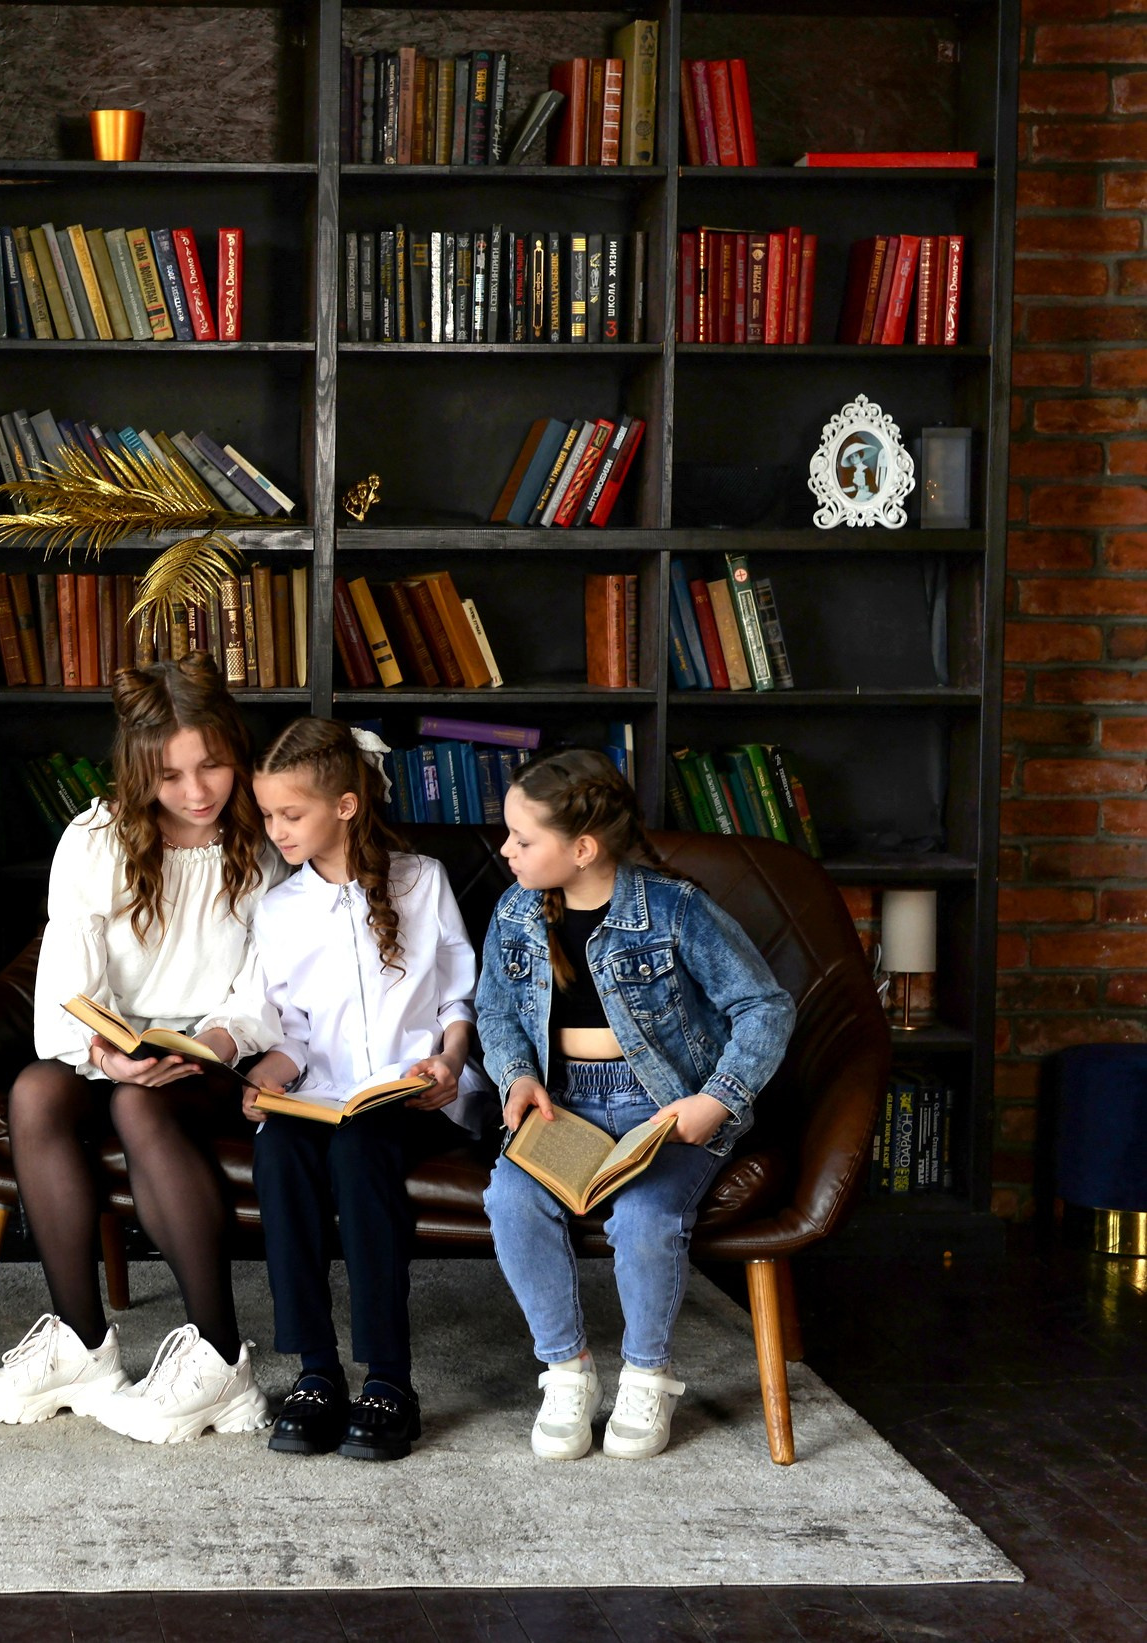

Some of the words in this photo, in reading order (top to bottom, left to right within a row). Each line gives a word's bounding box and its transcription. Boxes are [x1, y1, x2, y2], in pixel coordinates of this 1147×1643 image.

[133, 240, 147, 262] СЕМЬЯ
[491, 247, 499, 282] ИНТРИГИ
[608, 241, 618, 277] ЖИЗНИ
[188, 257, 199, 284] Дюма
[226, 257, 235, 286] Дюма
[550, 252, 559, 292] РОББИНС
[752, 264, 762, 294] КАТРИН
[870, 251, 883, 288] МАРИАННА
[950, 264, 958, 291] Дюма
[192, 284, 201, 295] А.
[227, 287, 235, 297] А.
[490, 282, 498, 306] СЕТЯХ
[607, 282, 616, 317] ШКОЛА
[950, 292, 957, 303] А.
[550, 292, 559, 330] ГАРОЛЬД
[562, 428, 578, 451] РОССИИ
[550, 464, 576, 509] КРЕСТНЫЙ
[570, 441, 586, 465] ОТЕЦ
[584, 458, 614, 512] АВТОМОБИЛИ
[451, 785, 460, 814] ЗАЩИТА
[885, 1092, 893, 1121] СИНГЕР
[884, 1122, 892, 1144] ФЛОМ
[899, 1112, 913, 1167] ФАРАОН
[894, 1132, 902, 1167] БОЛЕСЛАВ
[917, 1158, 925, 1184] ГУЛАГ
